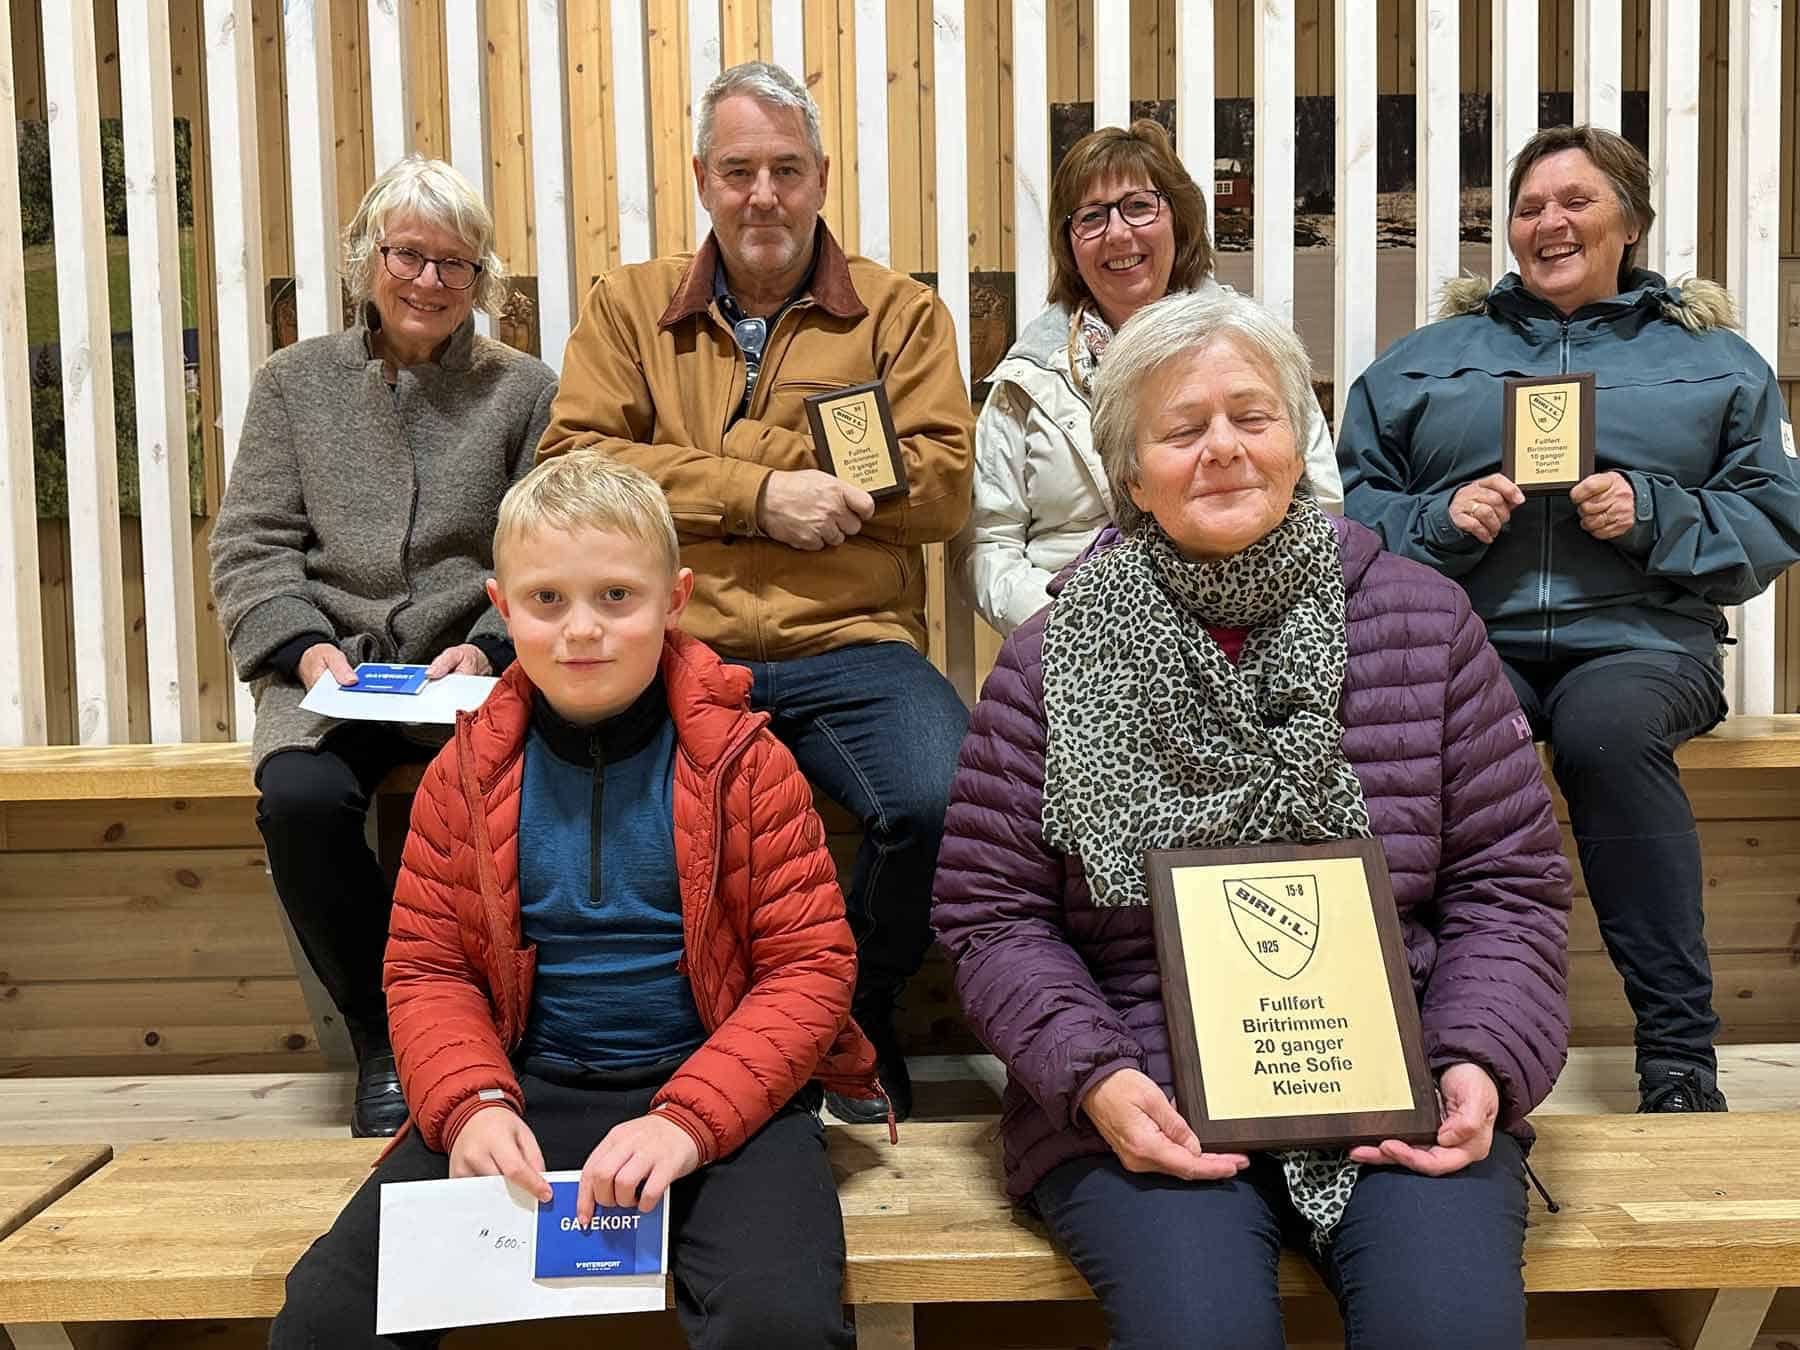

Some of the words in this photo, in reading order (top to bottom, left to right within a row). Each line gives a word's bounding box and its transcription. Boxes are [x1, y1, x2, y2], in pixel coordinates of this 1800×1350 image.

[1234, 887, 1274, 918] BIRI
[1256, 940, 1280, 954] 1925
[1259, 994, 1325, 1013] Fullført
[1243, 1016, 1349, 1033] Biritrimmen
[1254, 1039, 1276, 1054] 20
[1281, 1038, 1344, 1056] ganger
[1253, 1059, 1301, 1076] Anne
[1305, 1057, 1353, 1073] Sofie
[1272, 1079, 1341, 1096] Kleiven
